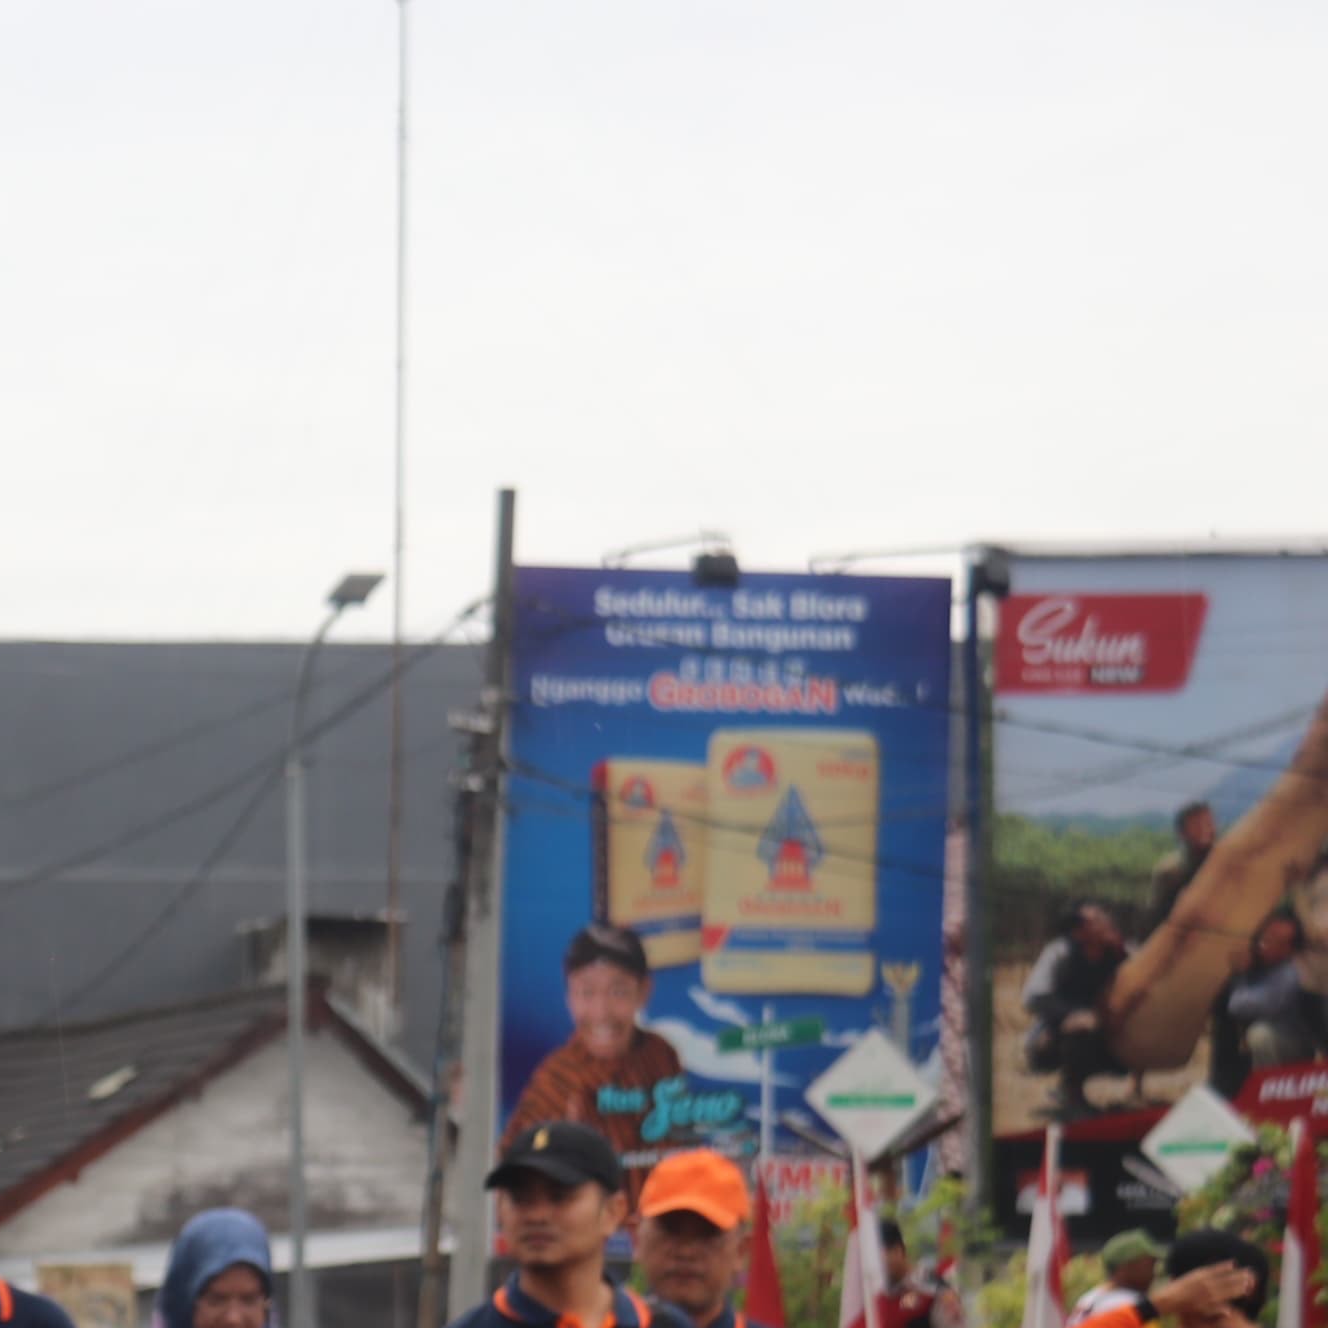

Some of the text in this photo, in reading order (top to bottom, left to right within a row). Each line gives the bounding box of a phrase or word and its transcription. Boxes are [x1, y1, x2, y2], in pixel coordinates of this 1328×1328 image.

[732, 590, 784, 619] Sak
[790, 593, 869, 622] Blora
[710, 624, 858, 653] Bangunan
[1016, 597, 1147, 665] Sukun
[649, 671, 840, 713] GROBOGAN
